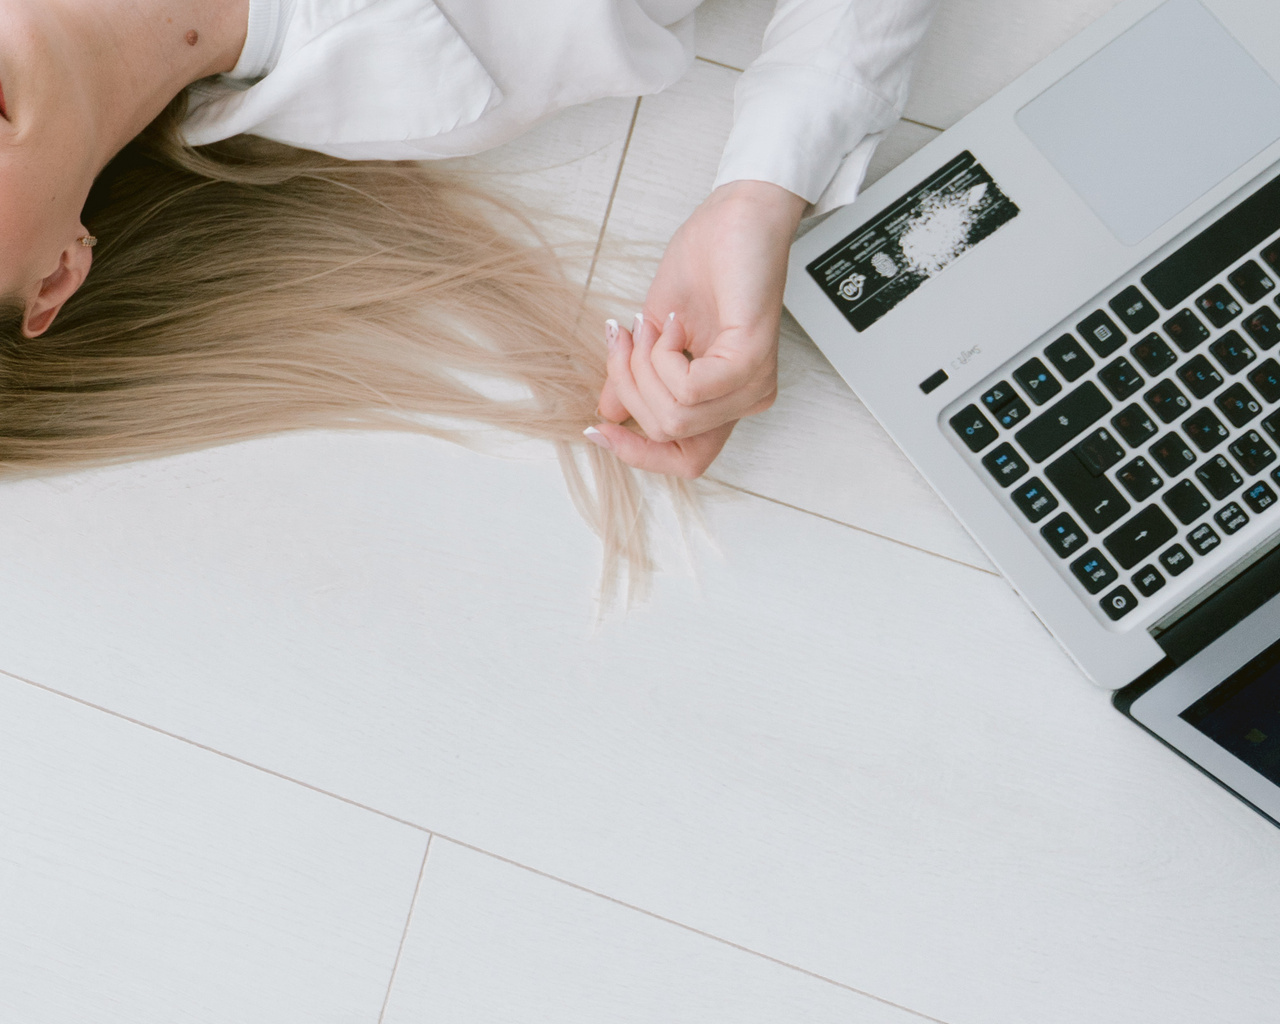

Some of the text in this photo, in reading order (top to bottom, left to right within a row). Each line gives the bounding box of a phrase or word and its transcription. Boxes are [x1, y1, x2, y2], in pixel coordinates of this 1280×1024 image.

[1260, 277, 1273, 289] N
[1227, 301, 1240, 314] M
[1242, 348, 1254, 359] K
[1210, 371, 1221, 381] L
[1218, 425, 1227, 436] P
[1258, 496, 1272, 507] F12
